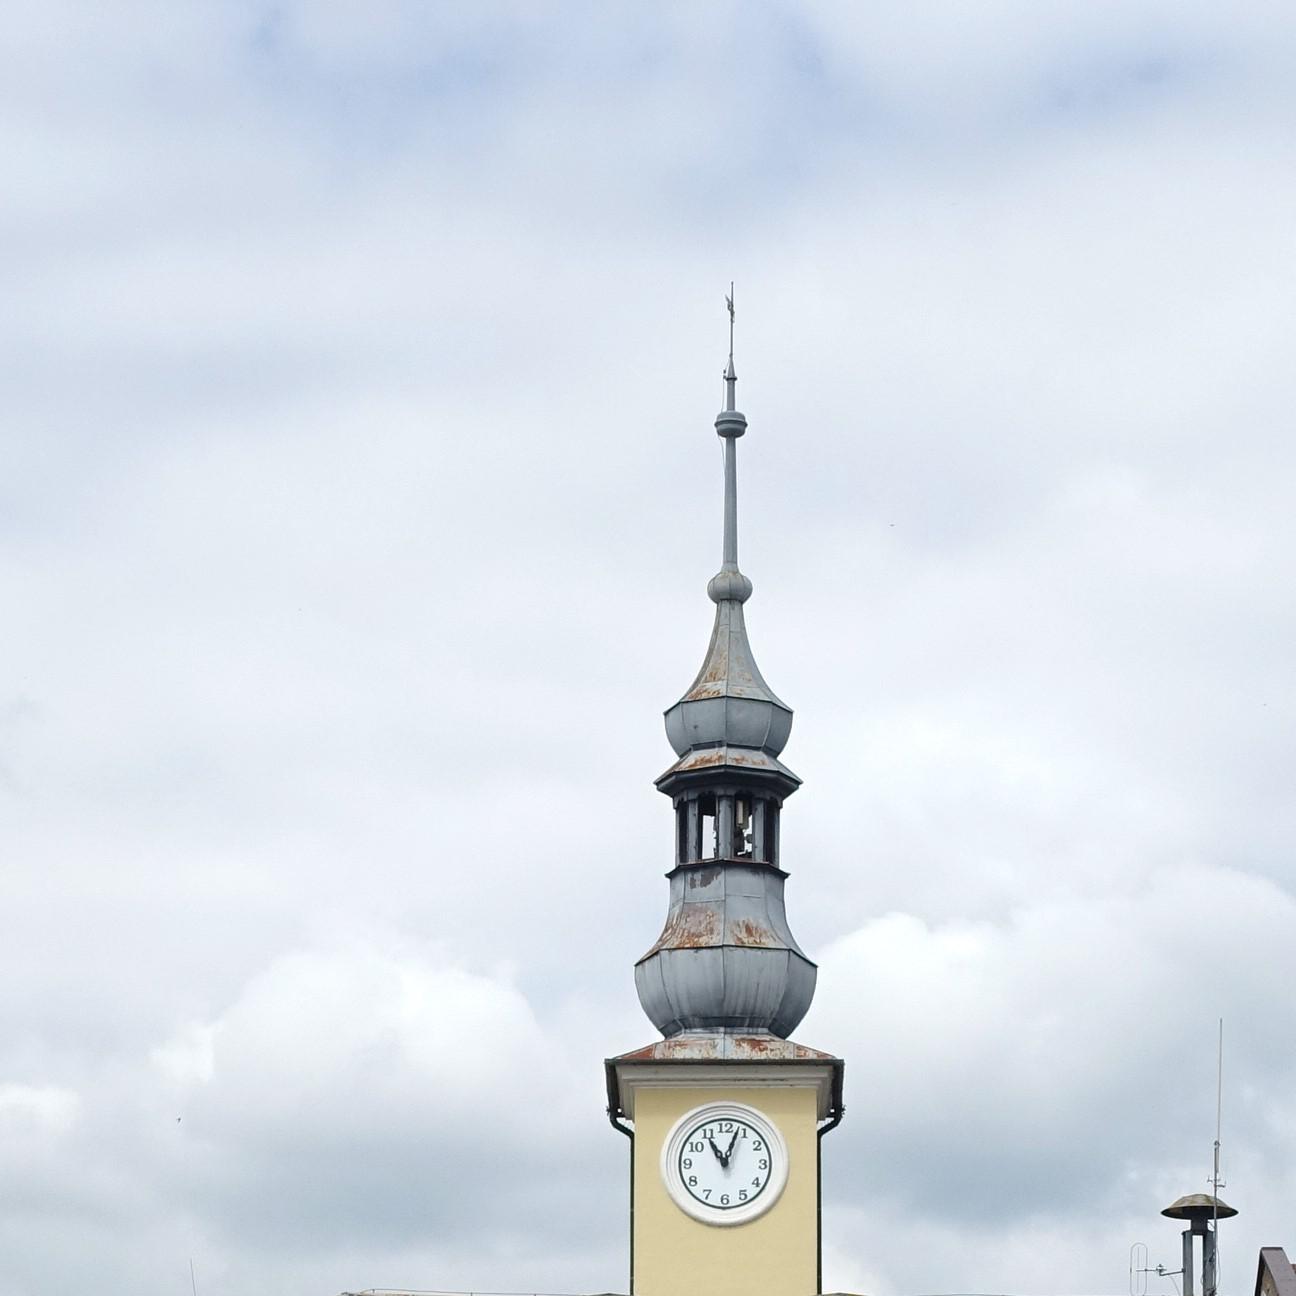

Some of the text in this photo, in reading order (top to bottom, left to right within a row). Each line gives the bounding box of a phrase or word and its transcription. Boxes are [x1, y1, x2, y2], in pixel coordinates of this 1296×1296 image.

[718, 1122, 734, 1133] 12
[741, 1128, 748, 1138] 1
[702, 1128, 715, 1139] 11
[689, 1141, 704, 1152] 10
[752, 1140, 762, 1151] 2
[683, 1158, 692, 1169] 9
[758, 1159, 767, 1170] 3
[688, 1176, 698, 1187] 8
[751, 1177, 761, 1187] 4
[703, 1189, 712, 1200] 7
[720, 1194, 730, 1205] 6
[738, 1190, 748, 1200] 5
